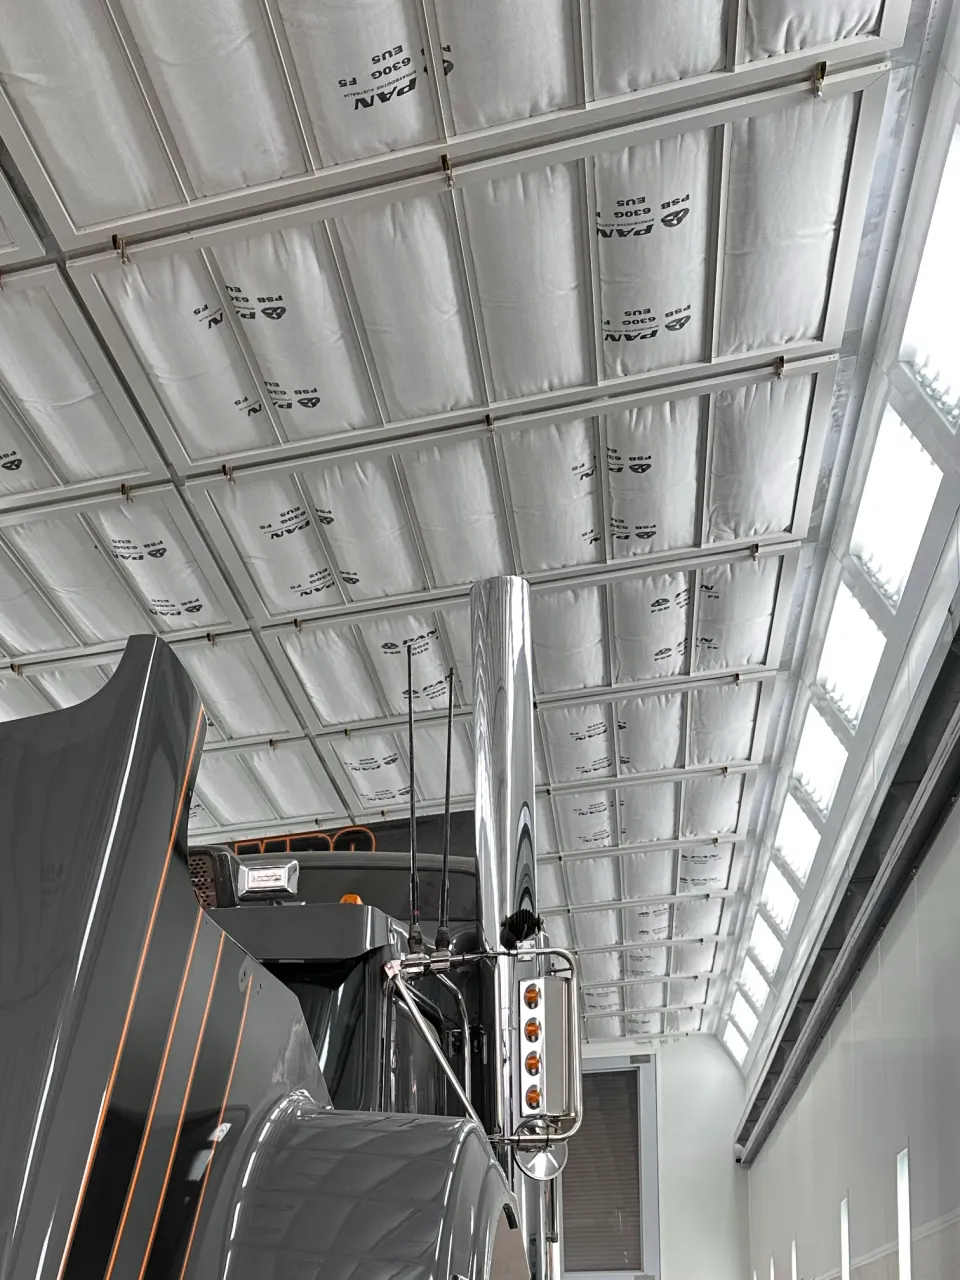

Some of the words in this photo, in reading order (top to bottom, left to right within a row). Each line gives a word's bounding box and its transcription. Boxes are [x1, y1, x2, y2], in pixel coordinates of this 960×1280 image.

[372, 45, 404, 65] EU5
[371, 57, 411, 79] 630G
[338, 77, 357, 87] F5
[354, 77, 417, 110] PAN
[616, 196, 646, 207] EU5
[661, 194, 690, 210] PSB
[613, 207, 652, 219] 630G
[193, 304, 208, 316] F5
[624, 308, 651, 317] EU5
[622, 316, 656, 326] 630G
[604, 329, 659, 342] PAN
[270, 519, 311, 540] PAN
[300, 580, 336, 597] PAN
